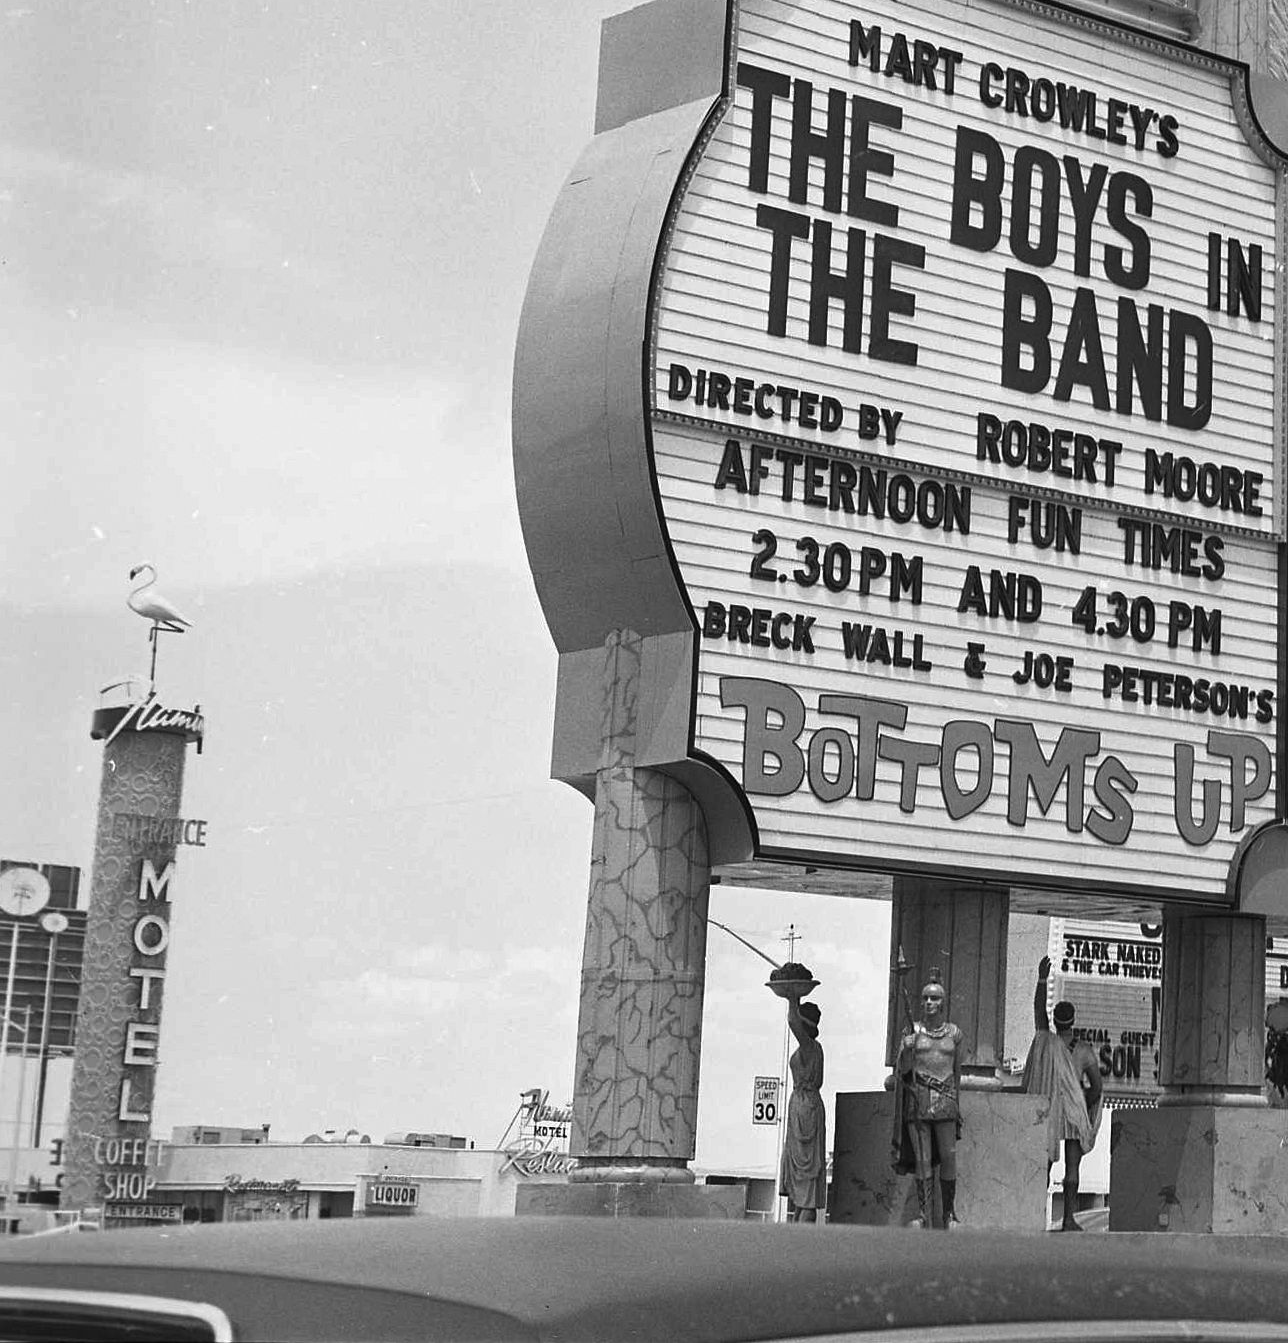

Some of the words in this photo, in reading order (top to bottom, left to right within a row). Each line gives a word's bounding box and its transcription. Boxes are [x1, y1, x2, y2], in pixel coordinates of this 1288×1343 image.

[848, 18, 963, 95] MART
[979, 61, 1180, 158] CROWLEY'S
[736, 61, 903, 227] THE
[950, 124, 1154, 290] BOYS
[1206, 232, 1262, 322] IN
[756, 203, 925, 366] THE
[1000, 268, 1214, 430] BAND
[668, 363, 844, 431] DIRECTED
[858, 404, 903, 445] BY
[976, 412, 1122, 489] ROBERT
[1144, 448, 1263, 516] MOORE
[714, 439, 971, 534] AFTERNOON
[1007, 495, 1082, 555] FUN
[1118, 517, 1225, 580] TIMES
[956, 565, 1042, 623] AND
[702, 600, 816, 654] BRECK
[842, 620, 932, 672] WALL
[964, 642, 986, 680] &
[1012, 650, 1074, 693] JOE
[1102, 663, 1275, 724] PETERSON'S
[1174, 730, 1274, 847] UP
[1065, 939, 1109, 959] STARK
[1117, 944, 1161, 964] NAKED
[1073, 959, 1093, 974] THE
[1098, 962, 1119, 976] CAR
[119, 859, 176, 1122] MOTEL
[1120, 1031, 1156, 1046] GUEST
[533, 1125, 567, 1138] MOTEL
[755, 1102, 775, 1121] 30
[103, 1172, 156, 1199] SHOP
[111, 1205, 176, 1218] ENTRANCE
[375, 1186, 416, 1203] LIQUOR
